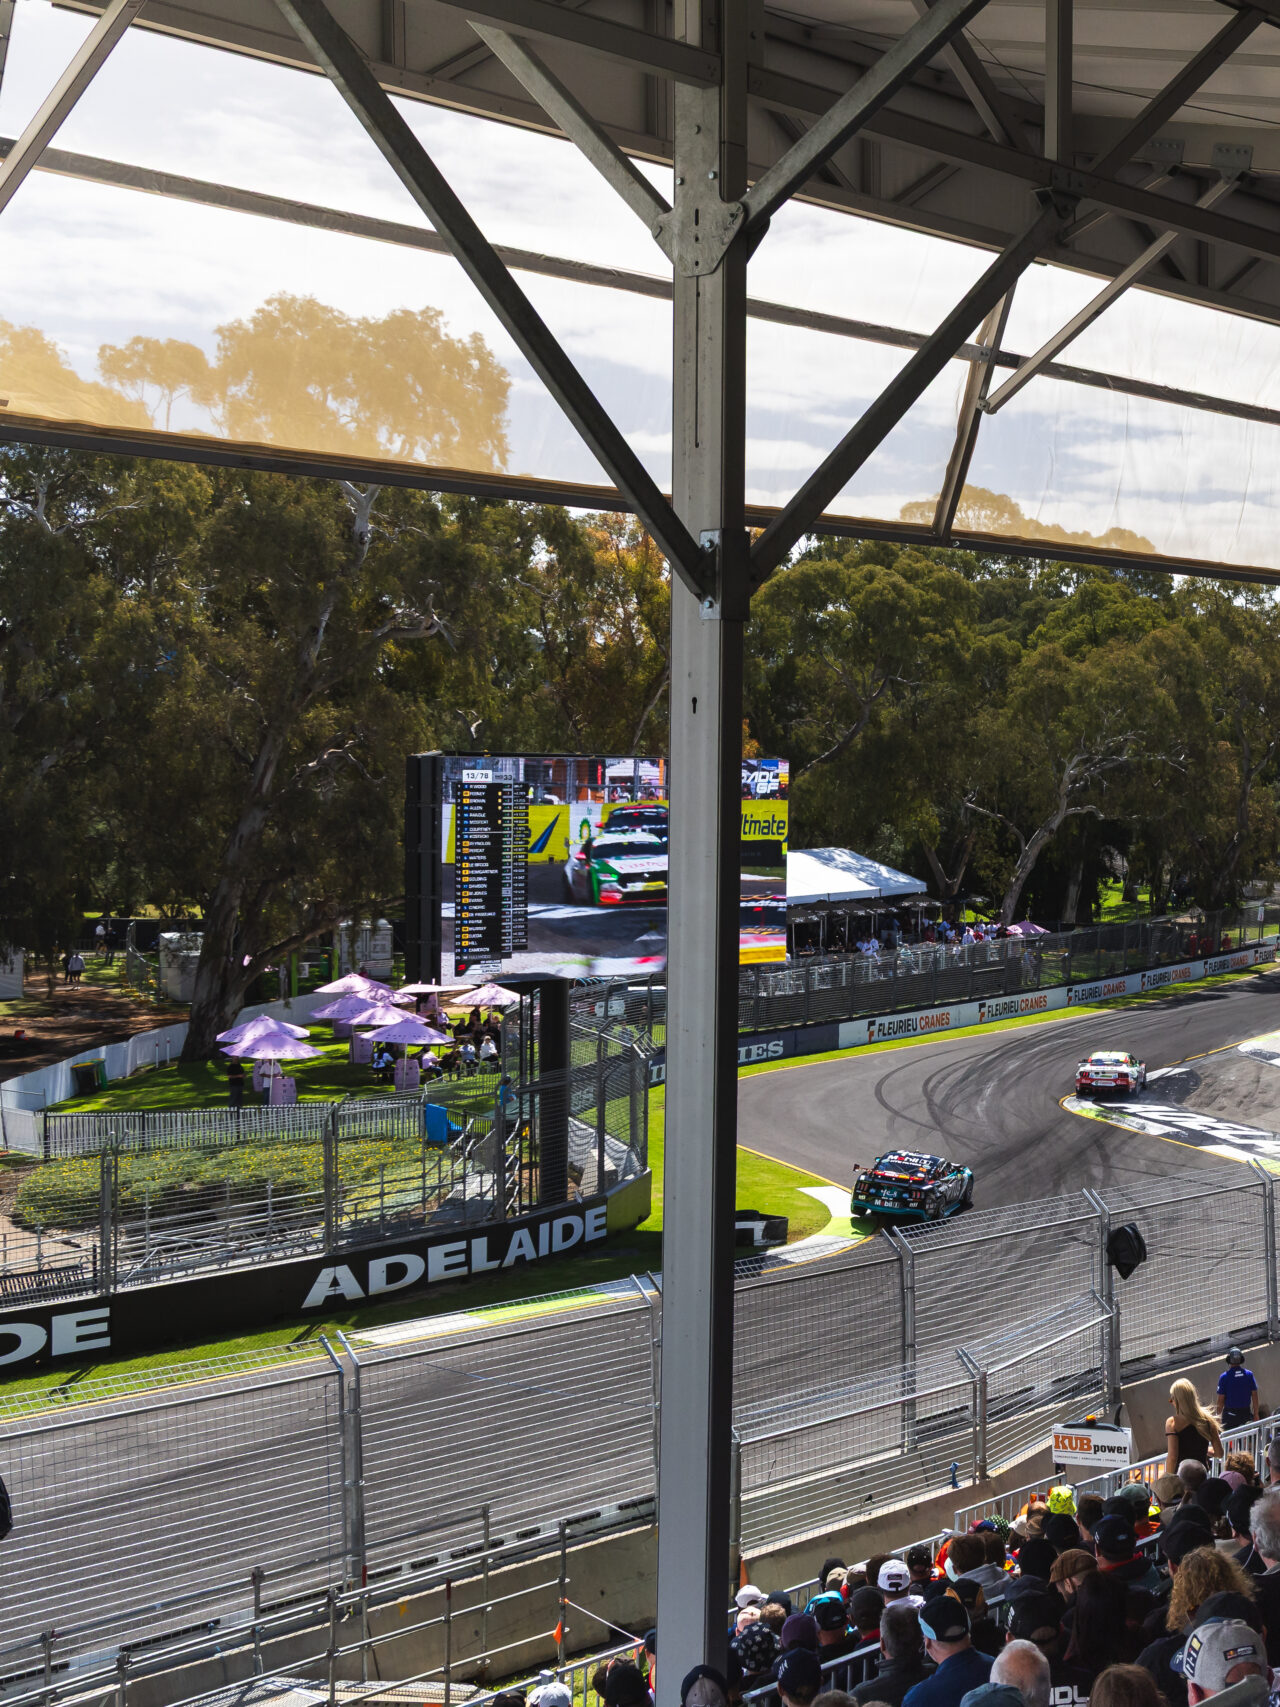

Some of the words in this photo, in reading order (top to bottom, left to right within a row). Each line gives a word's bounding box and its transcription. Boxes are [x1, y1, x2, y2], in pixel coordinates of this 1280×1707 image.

[1209, 959, 1229, 972] FLEURIEU
[1230, 954, 1249, 968] CRANES
[1147, 971, 1171, 986] FLEURIEU
[1172, 967, 1191, 981] CRANES
[1074, 986, 1102, 1001] FLEURIEU
[1102, 980, 1126, 996] CRANES
[987, 1000, 1019, 1018] FLEURIEU
[1020, 995, 1048, 1012] CRANES
[877, 1017, 918, 1037] FLEURIEU
[919, 1012, 951, 1031] CRANES
[301, 1205, 608, 1309] ADELAIDE
[1053, 1434, 1092, 1452] KUB
[1093, 1444, 1127, 1454] power
